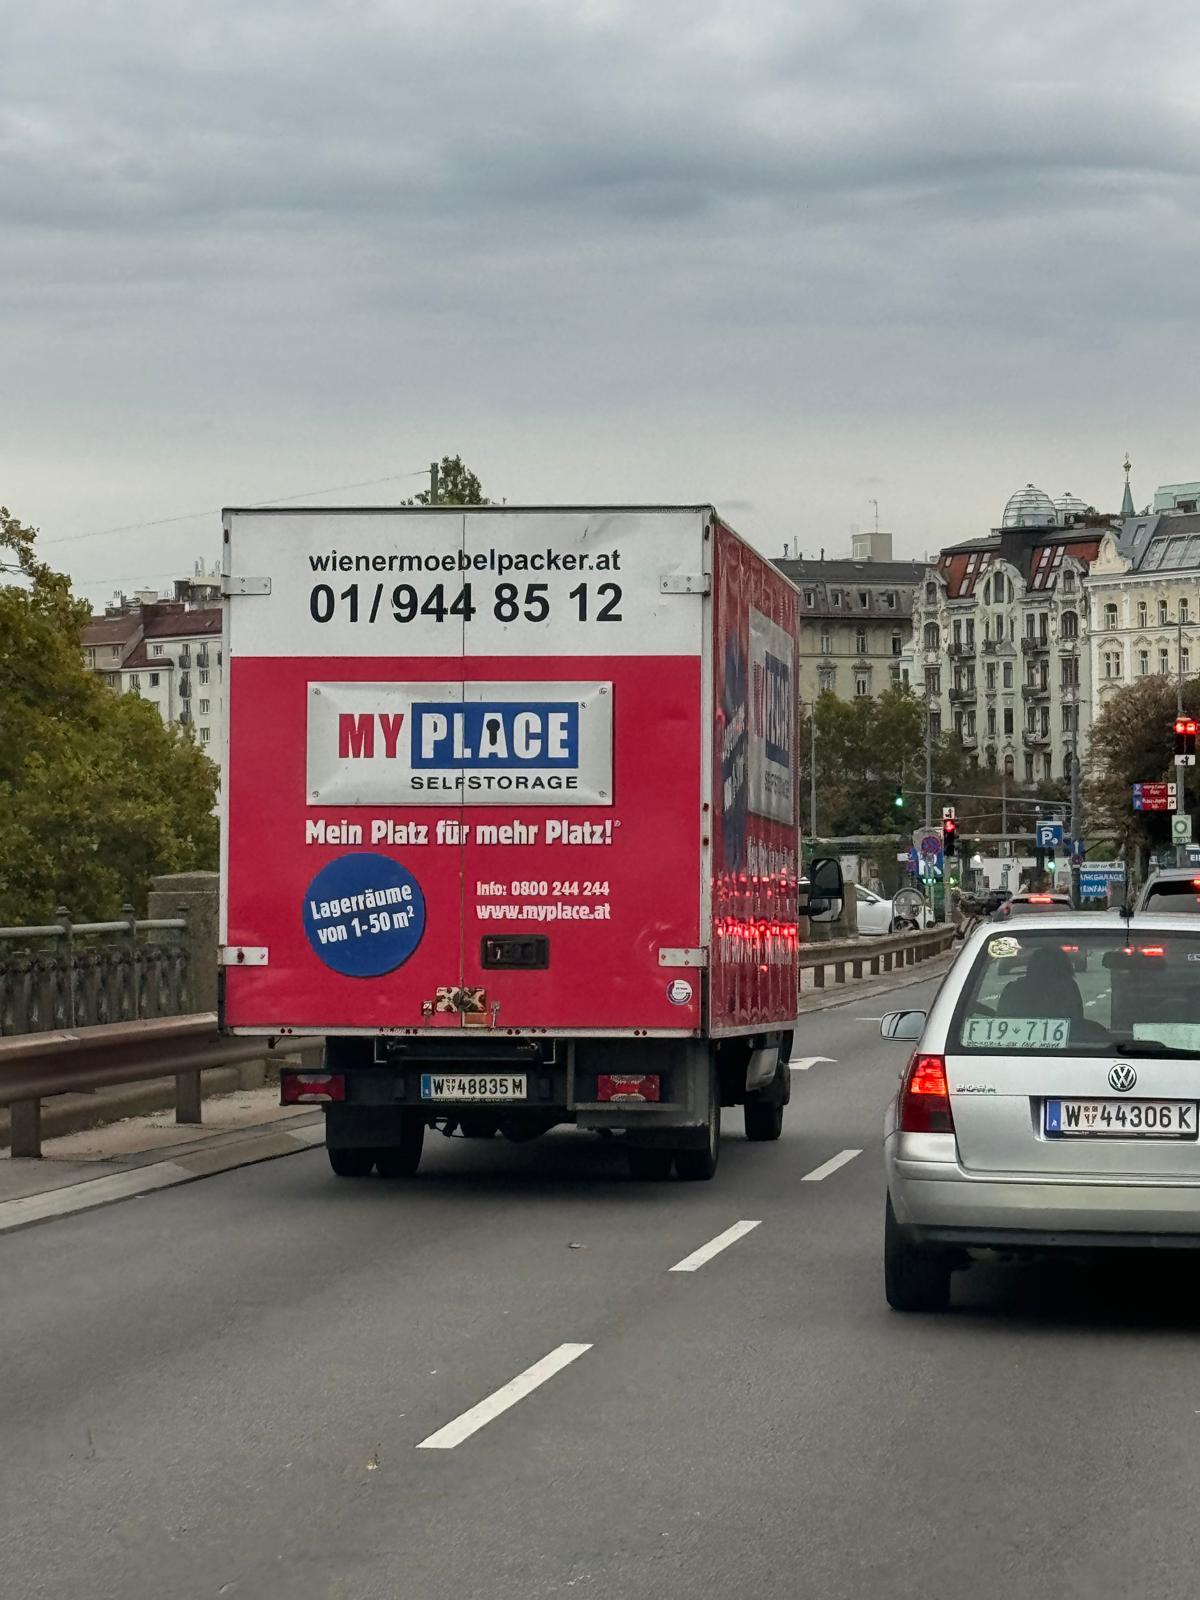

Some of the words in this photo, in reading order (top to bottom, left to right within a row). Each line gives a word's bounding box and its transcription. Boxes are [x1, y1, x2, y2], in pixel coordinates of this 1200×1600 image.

[309, 549, 621, 575] wienermoebelpacker.at
[310, 583, 476, 623] 01/944
[493, 582, 550, 622] 85
[569, 582, 623, 622] 12
[338, 713, 404, 758] MY
[421, 712, 569, 759] PLACE
[411, 776, 579, 790] SELFSTORAGE
[305, 819, 362, 845] Mein
[371, 819, 428, 845] Platz
[436, 819, 469, 845] für
[476, 819, 538, 844] mehr
[476, 880, 507, 896] Info:
[511, 880, 548, 896] 0800
[552, 881, 579, 896] 244
[582, 881, 610, 896] 244
[310, 884, 412, 920] Lagerräume
[476, 902, 611, 921] www.myplace.at
[317, 923, 348, 944] von
[433, 1079, 444, 1095] W
[457, 1079, 509, 1095] 48835
[1065, 1105, 1081, 1127] W
[1100, 1105, 1172, 1128] 44306
[1178, 1106, 1192, 1129] K
